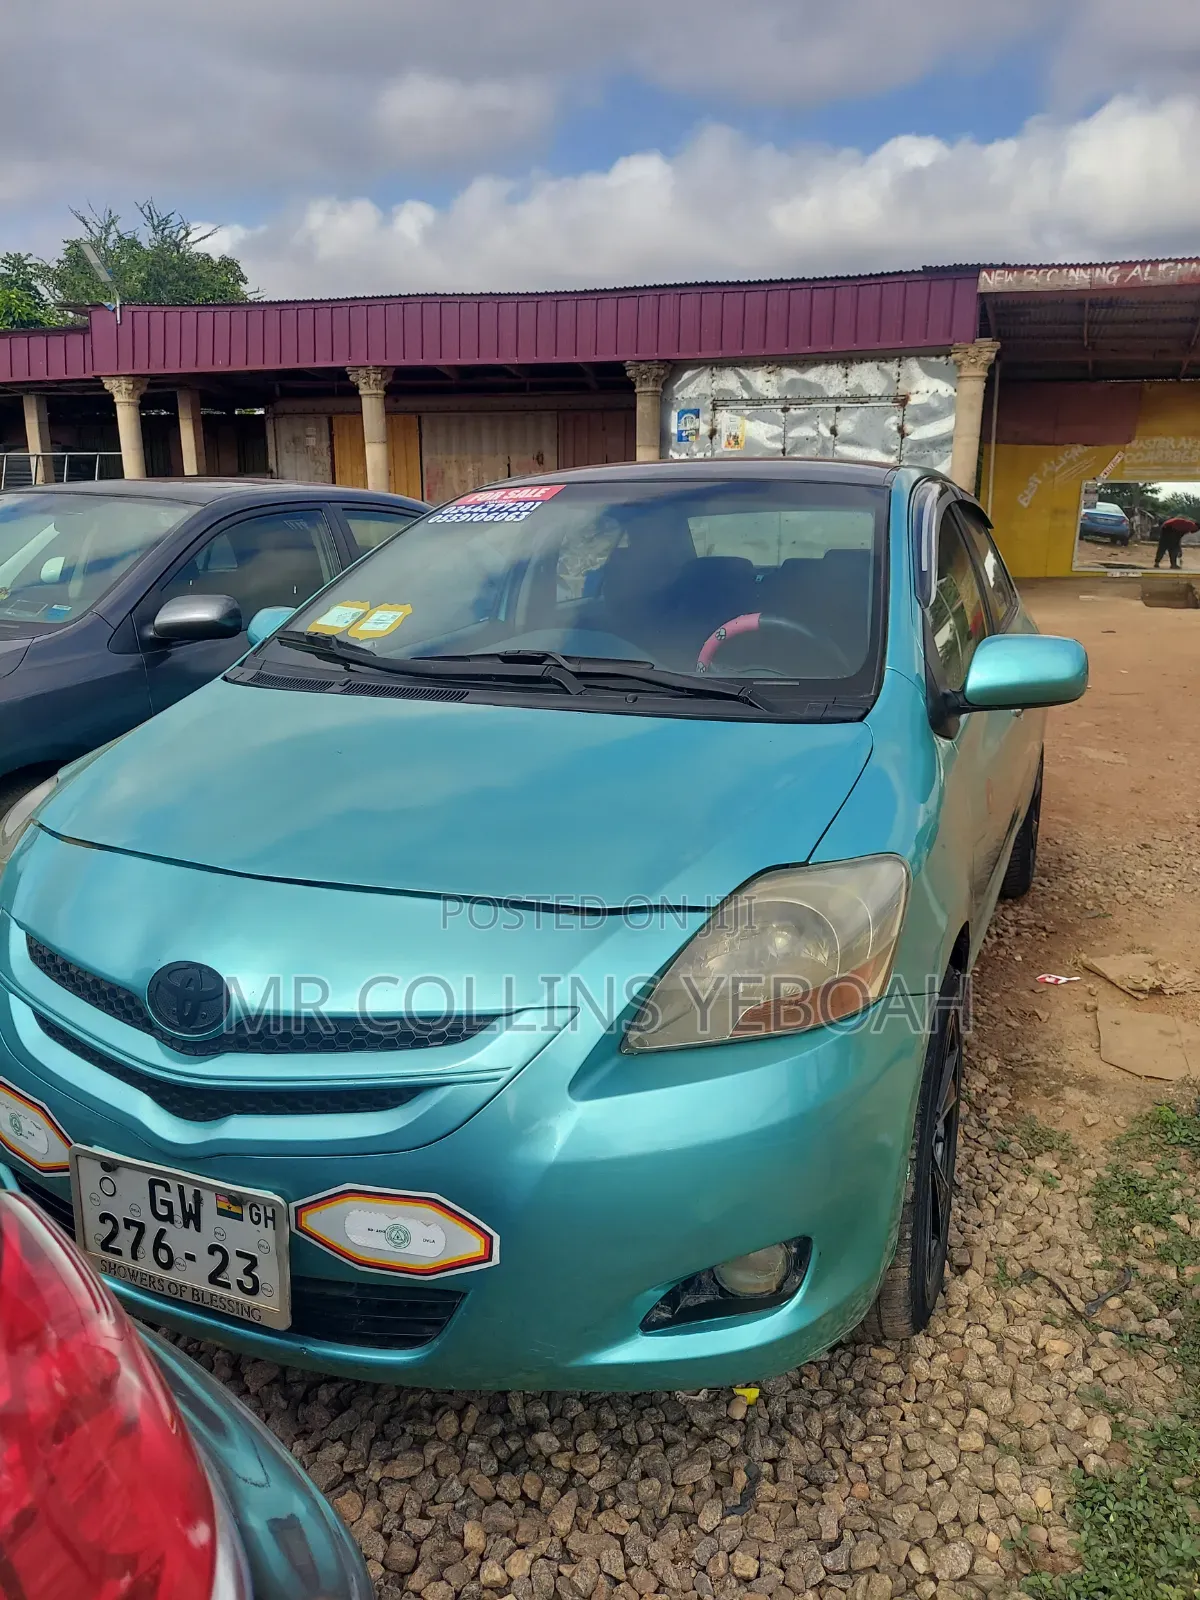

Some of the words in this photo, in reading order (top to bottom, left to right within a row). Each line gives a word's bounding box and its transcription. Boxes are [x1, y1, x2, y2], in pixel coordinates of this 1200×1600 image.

[981, 269, 1016, 286] NEW
[467, 491, 505, 503] FOR
[503, 487, 551, 500] SALE
[427, 511, 532, 524] 0559106063
[148, 1177, 201, 1233] GW
[249, 1203, 276, 1230] GH
[100, 1259, 164, 1293] SHOWERS
[168, 1281, 187, 1298] OF
[191, 1287, 262, 1322] BLESSING
